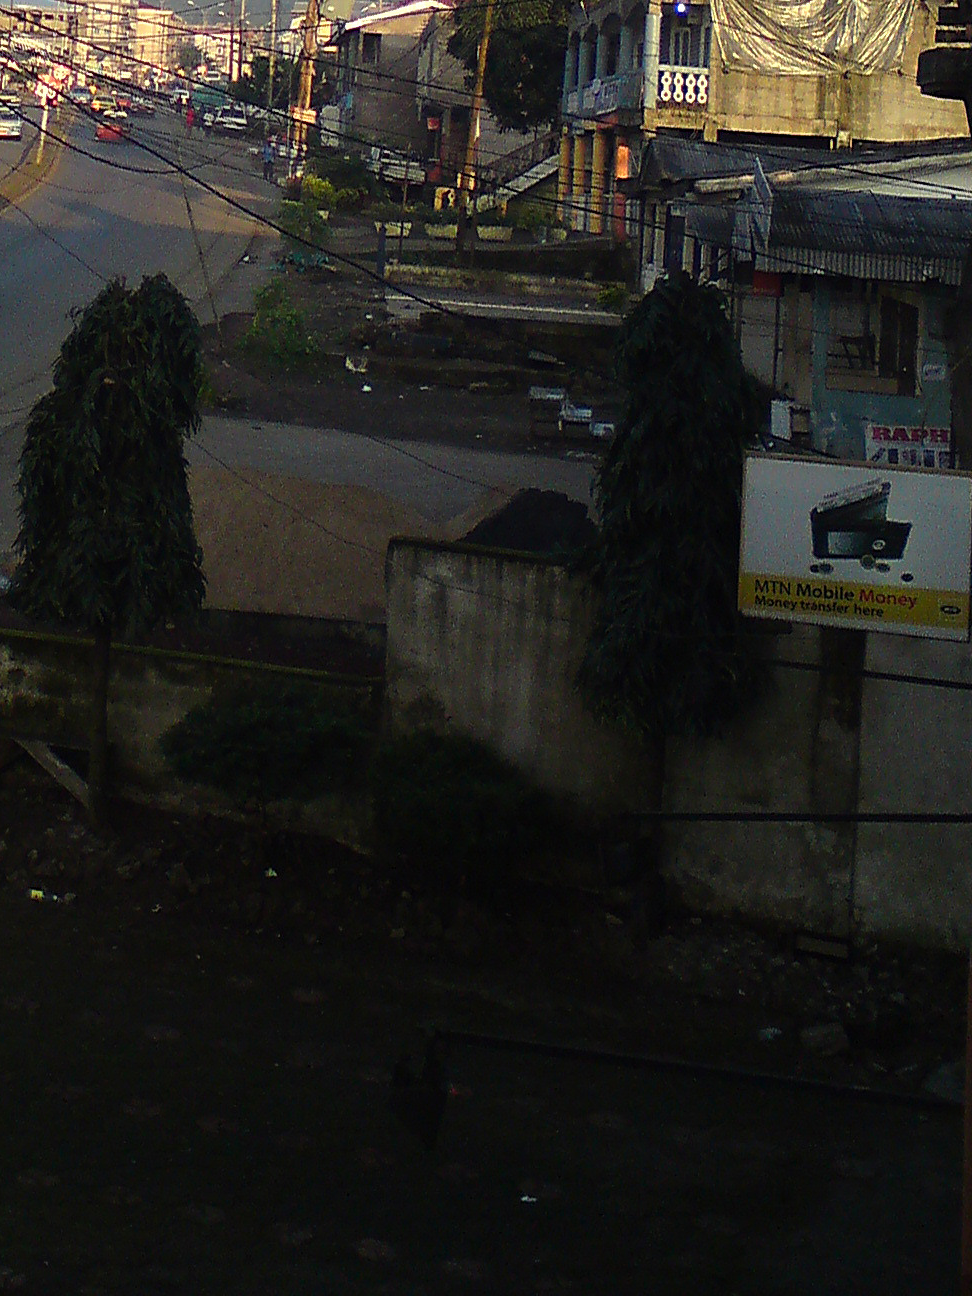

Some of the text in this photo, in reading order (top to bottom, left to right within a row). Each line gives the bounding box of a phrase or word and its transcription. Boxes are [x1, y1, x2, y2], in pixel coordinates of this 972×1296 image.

[754, 579, 917, 609] MTN Mobile Money
[754, 594, 884, 618] Money transfer here
